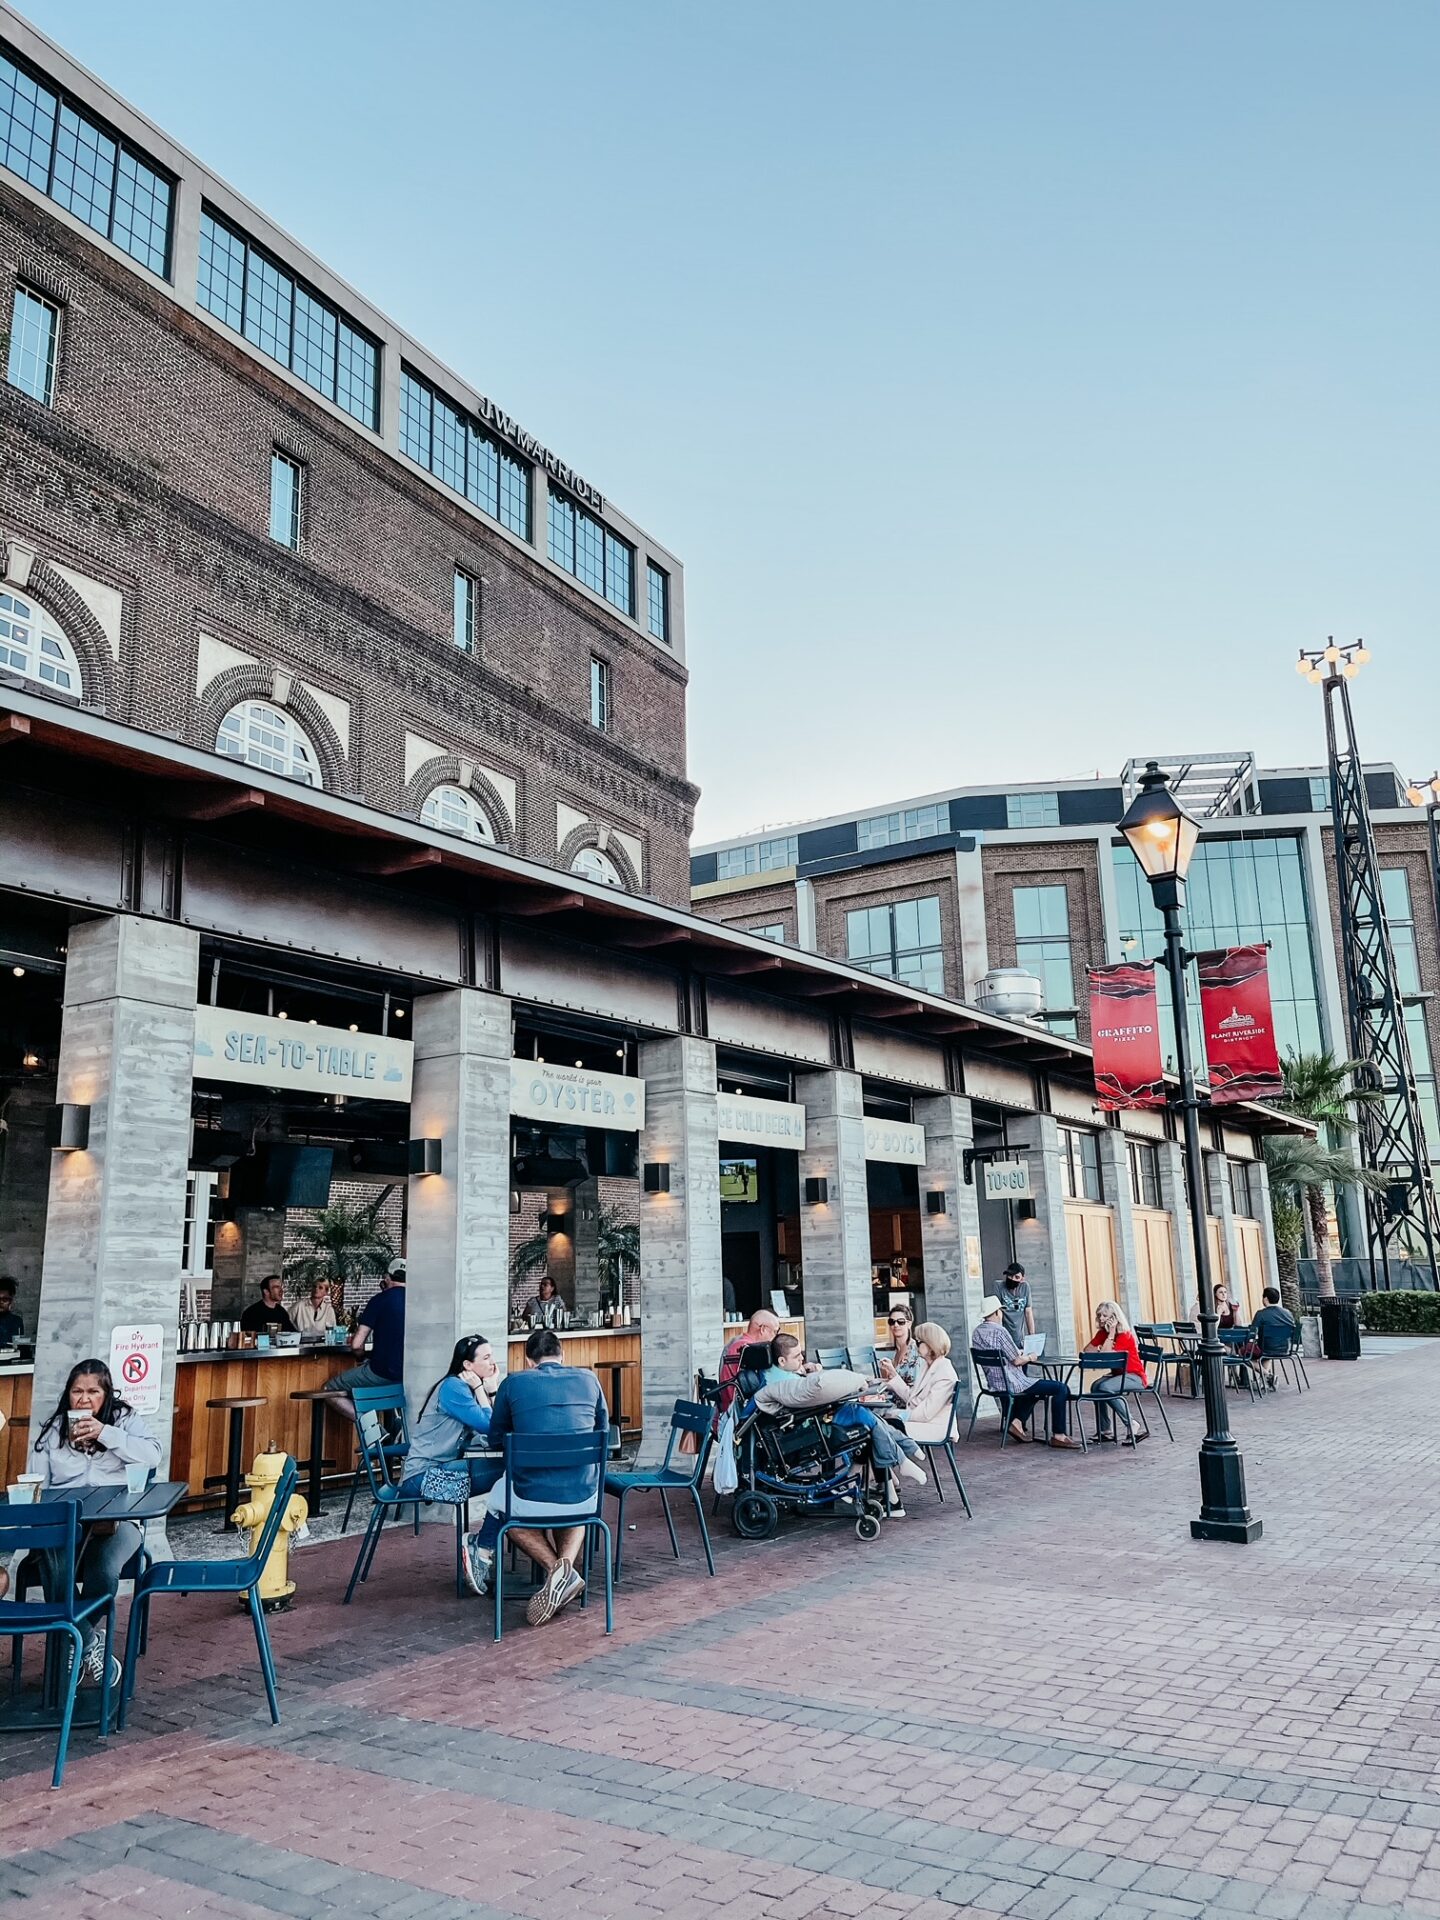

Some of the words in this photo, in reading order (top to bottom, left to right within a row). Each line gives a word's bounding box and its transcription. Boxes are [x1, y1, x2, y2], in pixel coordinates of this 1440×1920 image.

[515, 424, 606, 513] MARRIOTT
[1097, 1025, 1152, 1037] GRAFFITO
[1232, 1028, 1265, 1037] RIVERSIDE
[225, 1031, 378, 1080] SEA-TO-TABLE
[530, 1080, 616, 1115] OYSTER
[718, 1106, 733, 1130] CE
[765, 1111, 792, 1136] BEER
[131, 1333, 143, 1342] Dry
[131, 1342, 159, 1351] Hydrant
